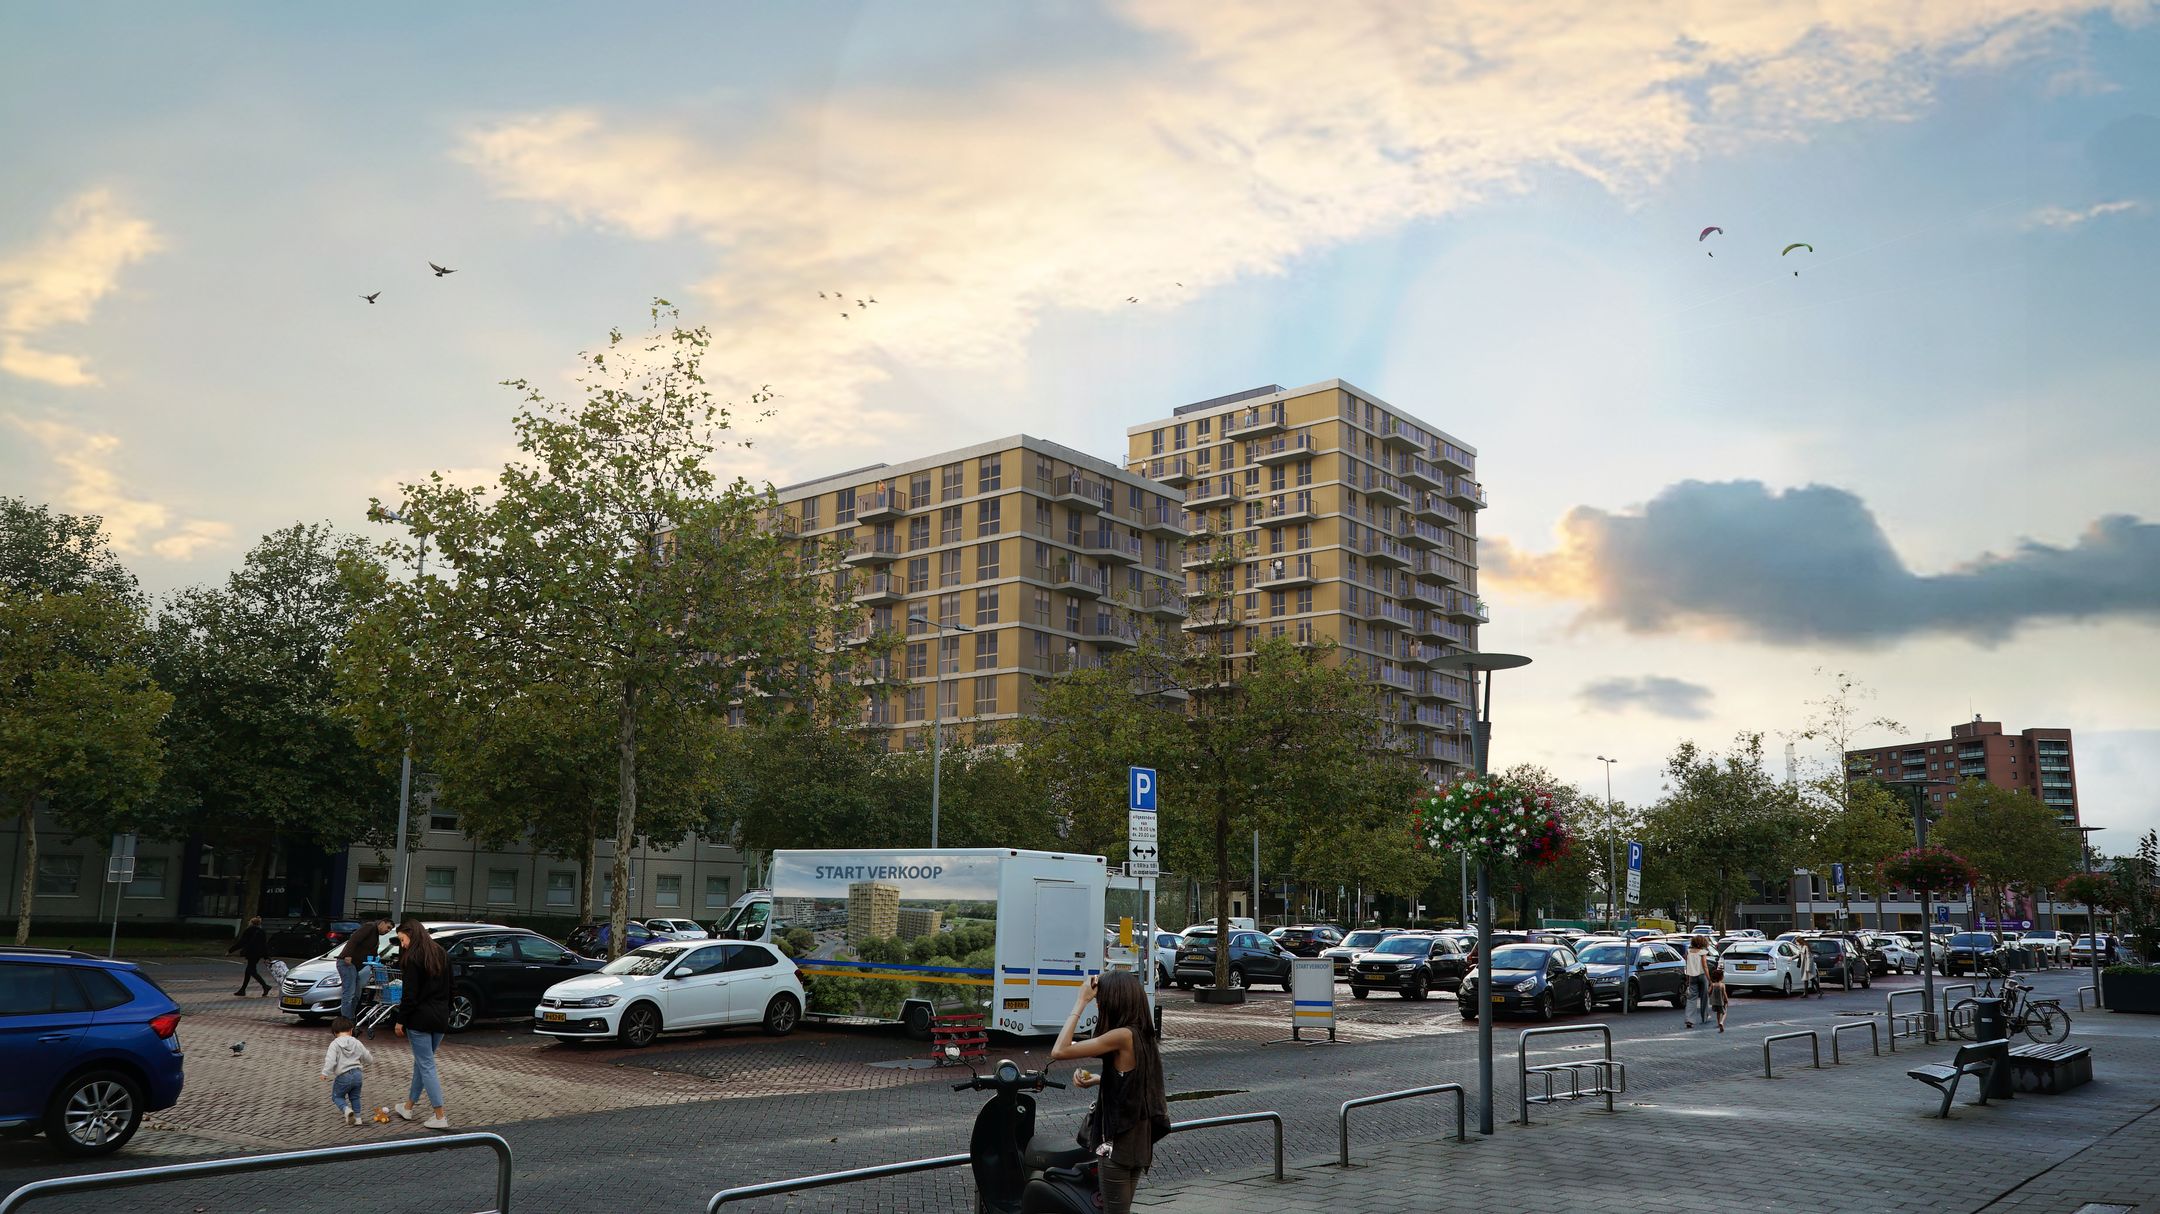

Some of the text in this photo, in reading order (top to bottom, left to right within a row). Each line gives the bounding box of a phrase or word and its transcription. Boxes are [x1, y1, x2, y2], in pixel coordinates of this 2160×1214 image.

[1136, 772, 1151, 806] P
[1632, 845, 1640, 868] P
[815, 866, 943, 880] START VERKOOP
[1939, 907, 1946, 916] P
